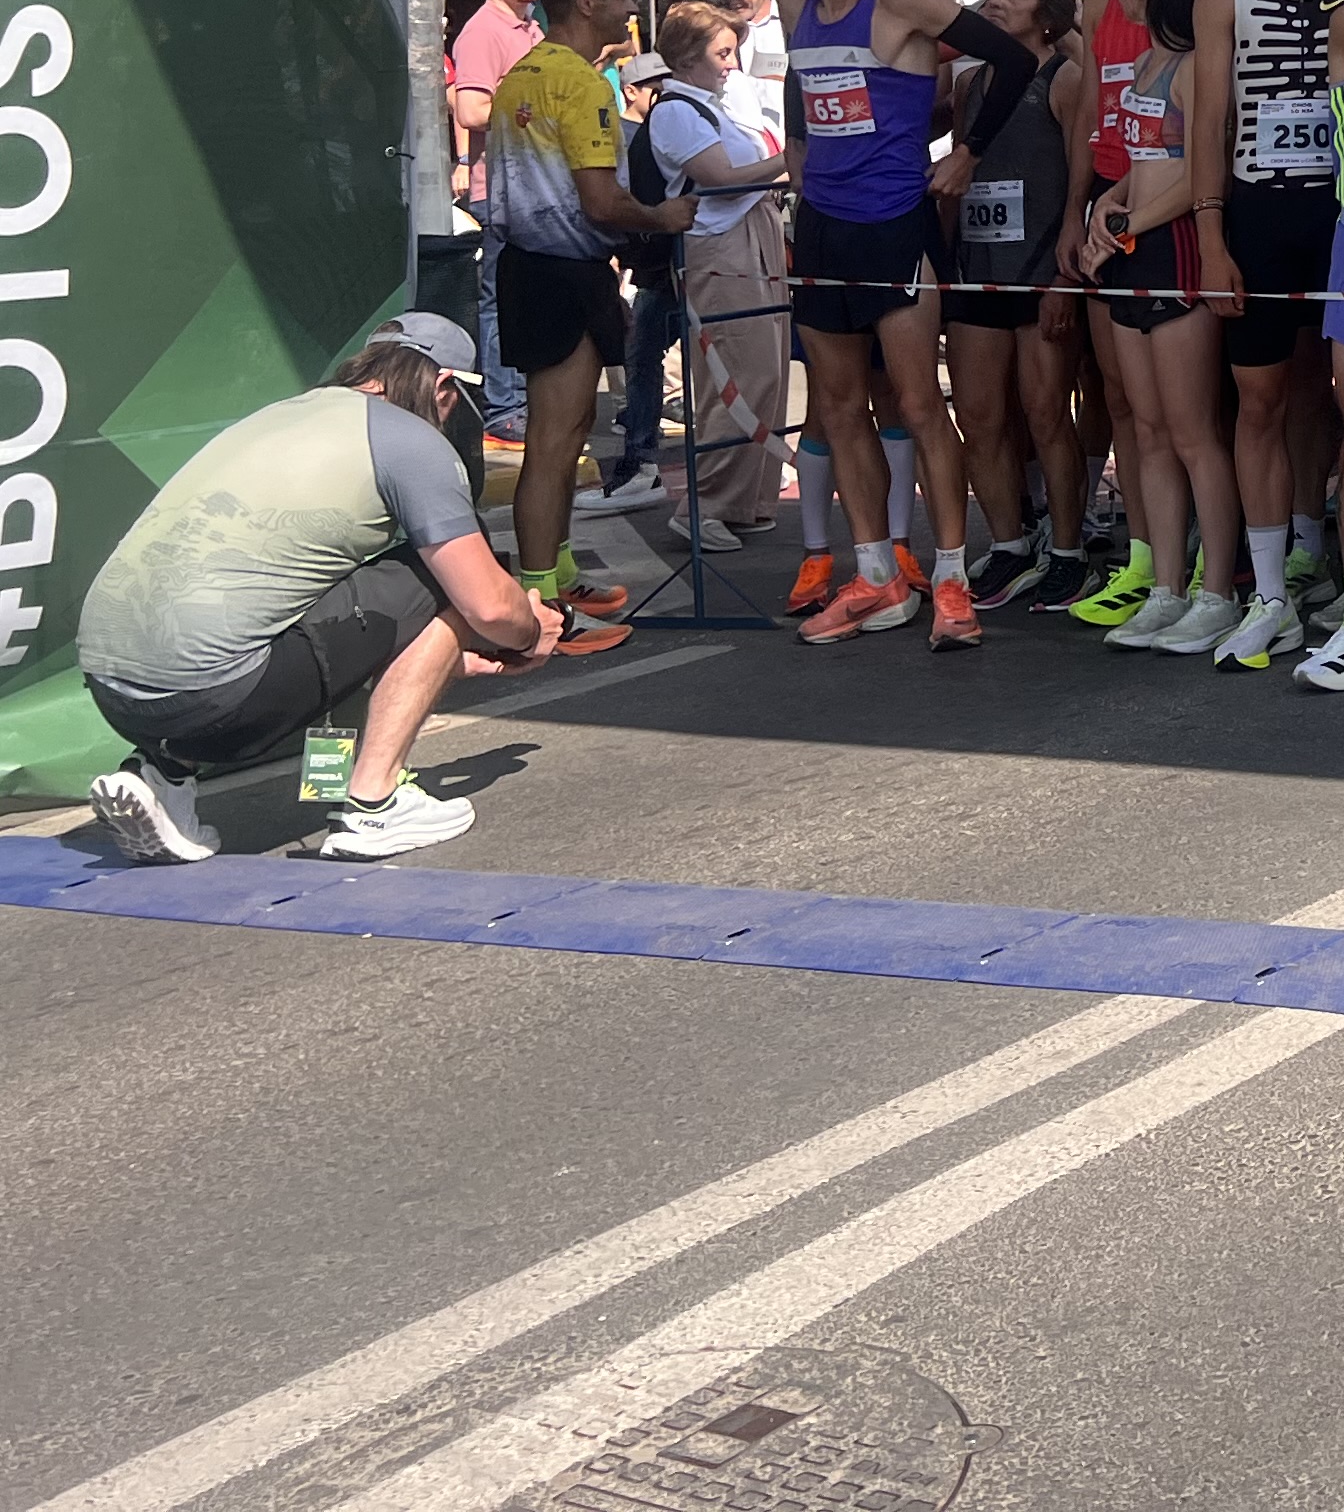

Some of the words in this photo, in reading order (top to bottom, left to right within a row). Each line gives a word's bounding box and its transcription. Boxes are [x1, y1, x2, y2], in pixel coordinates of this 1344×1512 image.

[813, 97, 845, 122] 65
[1124, 116, 1141, 144] 58
[1273, 123, 1330, 149] 250
[966, 202, 1008, 227] 208
[358, 818, 386, 830] HOKA
